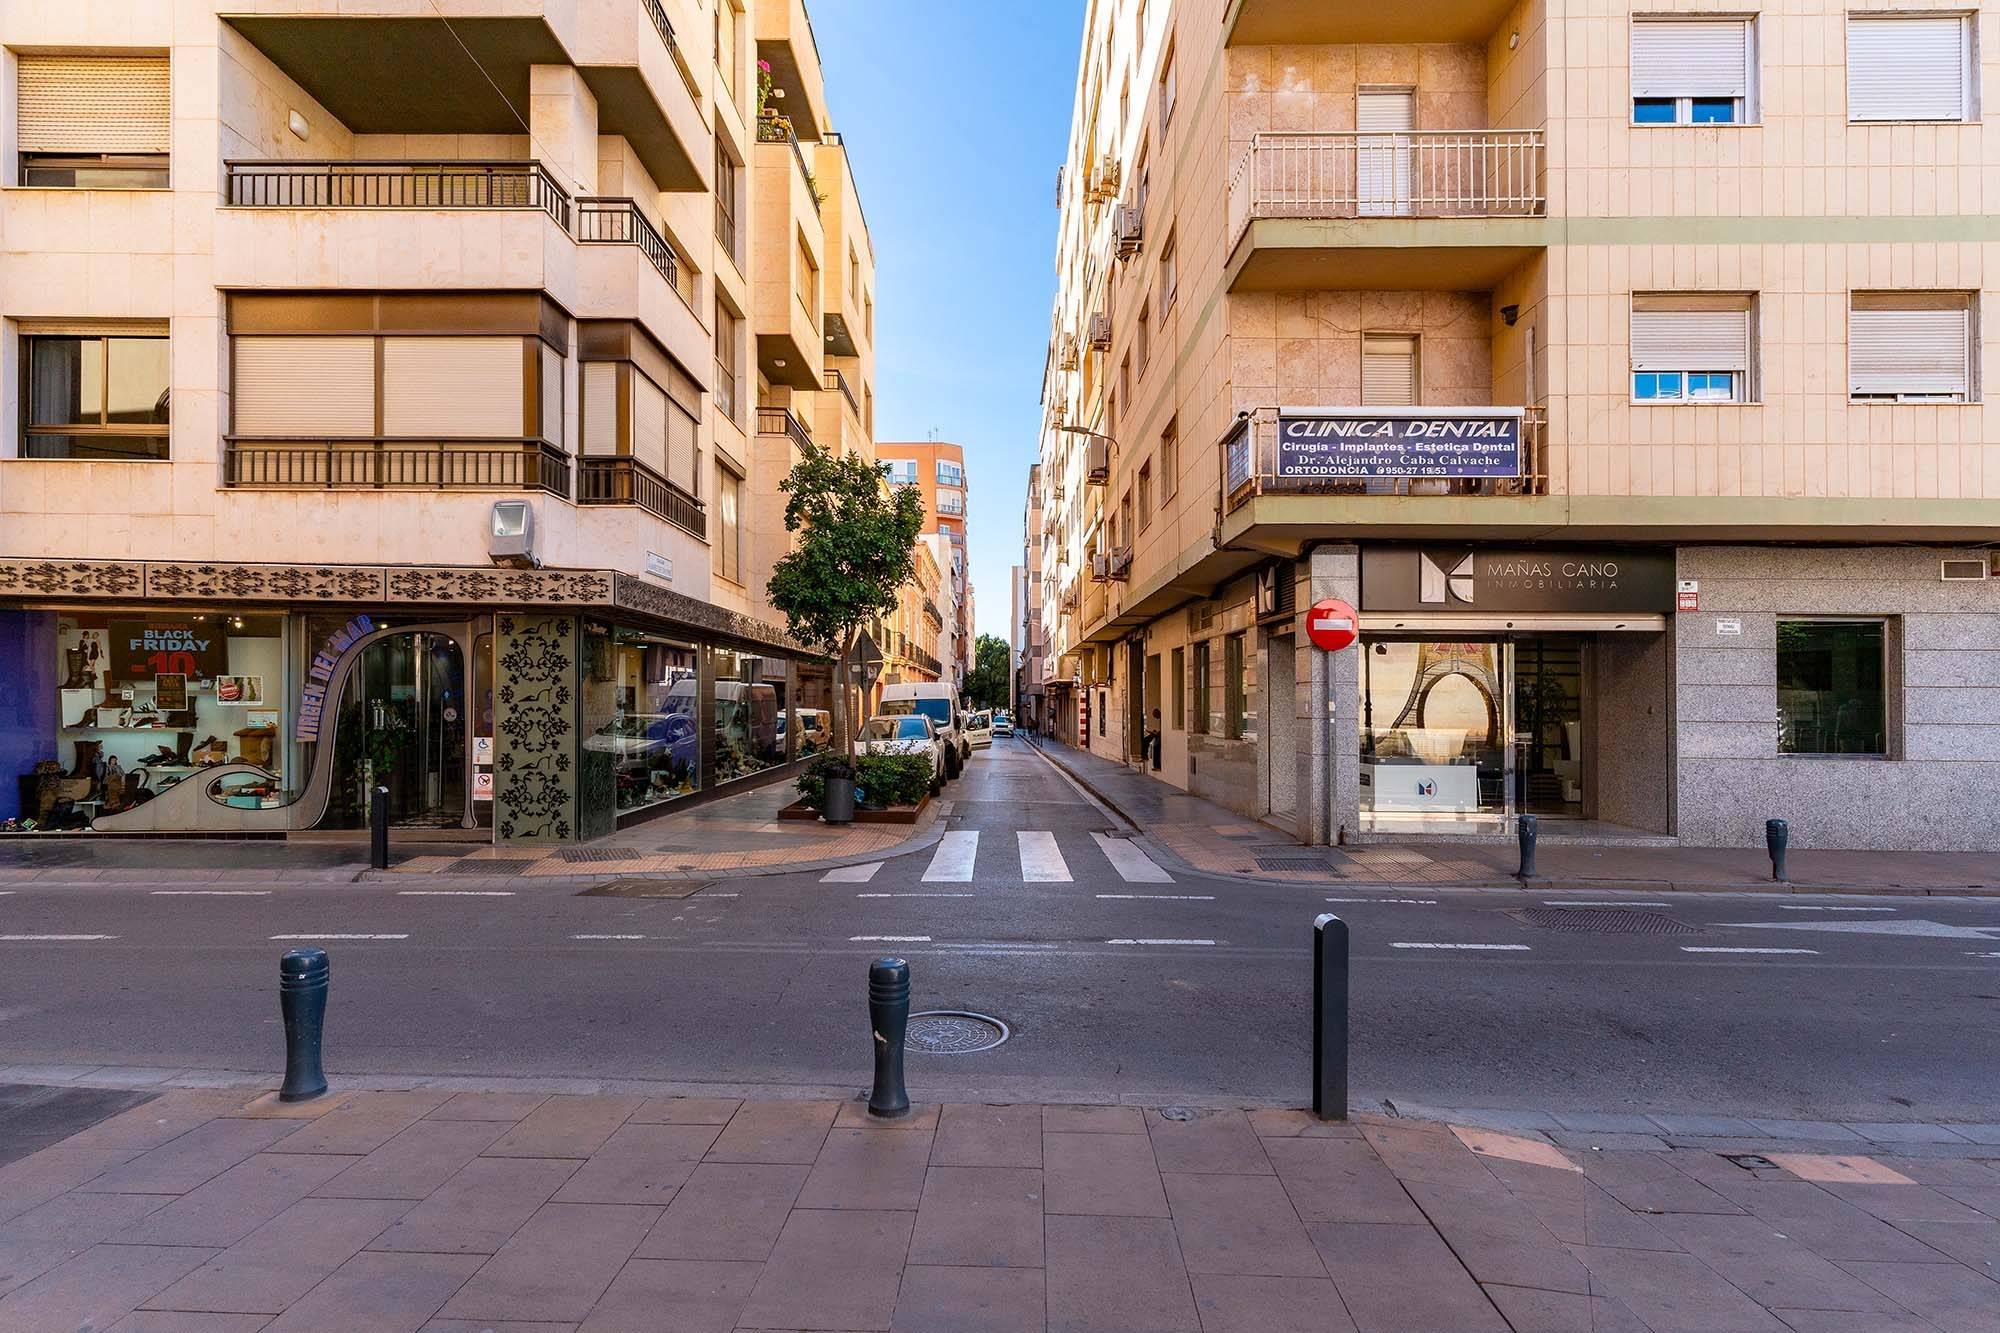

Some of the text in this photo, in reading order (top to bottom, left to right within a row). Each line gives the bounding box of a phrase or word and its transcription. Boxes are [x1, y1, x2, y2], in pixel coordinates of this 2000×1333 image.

[1286, 421, 1512, 437] CLINICA DENTAL
[1282, 442, 1329, 453] Cirugía
[1340, 442, 1404, 454] Implantes
[1415, 442, 1469, 452] Estetica
[1473, 442, 1515, 452] Dental
[1298, 455, 1500, 466] Dr. Alejandro Caba Calvache
[1285, 466, 1369, 475] ORTODONCIA
[1487, 559, 1618, 577] MAÑAS CANO
[1487, 579, 1618, 589] INMOBILIARIA
[143, 629, 193, 639] BLACK
[129, 639, 210, 651] FRIDAY
[296, 614, 375, 743] VIRGEN DEL MAR
